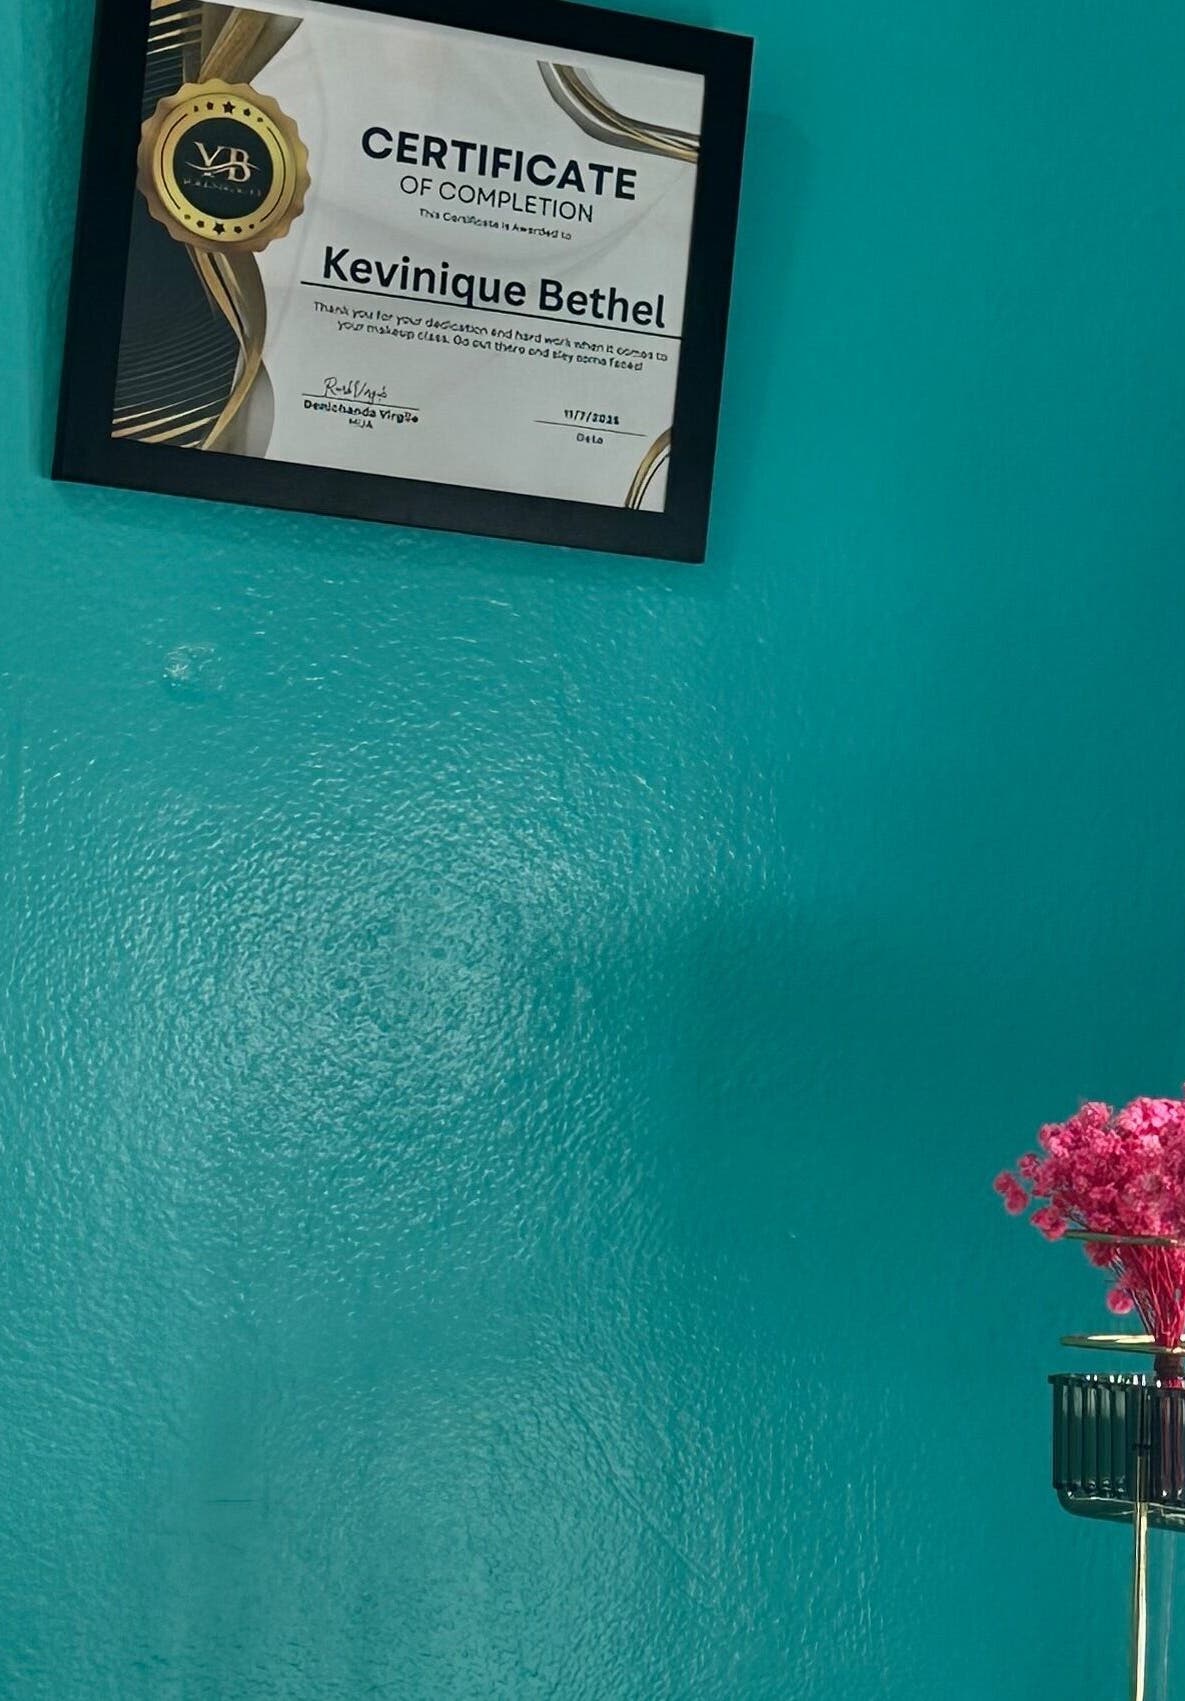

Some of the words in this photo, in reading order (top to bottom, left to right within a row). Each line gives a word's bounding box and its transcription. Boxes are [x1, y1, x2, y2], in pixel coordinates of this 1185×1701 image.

[361, 126, 638, 201] CERTIFICATE
[400, 175, 433, 197] OF
[439, 181, 594, 223] COMPLETION
[323, 246, 527, 307] Kevinique
[539, 278, 666, 329] Bethel
